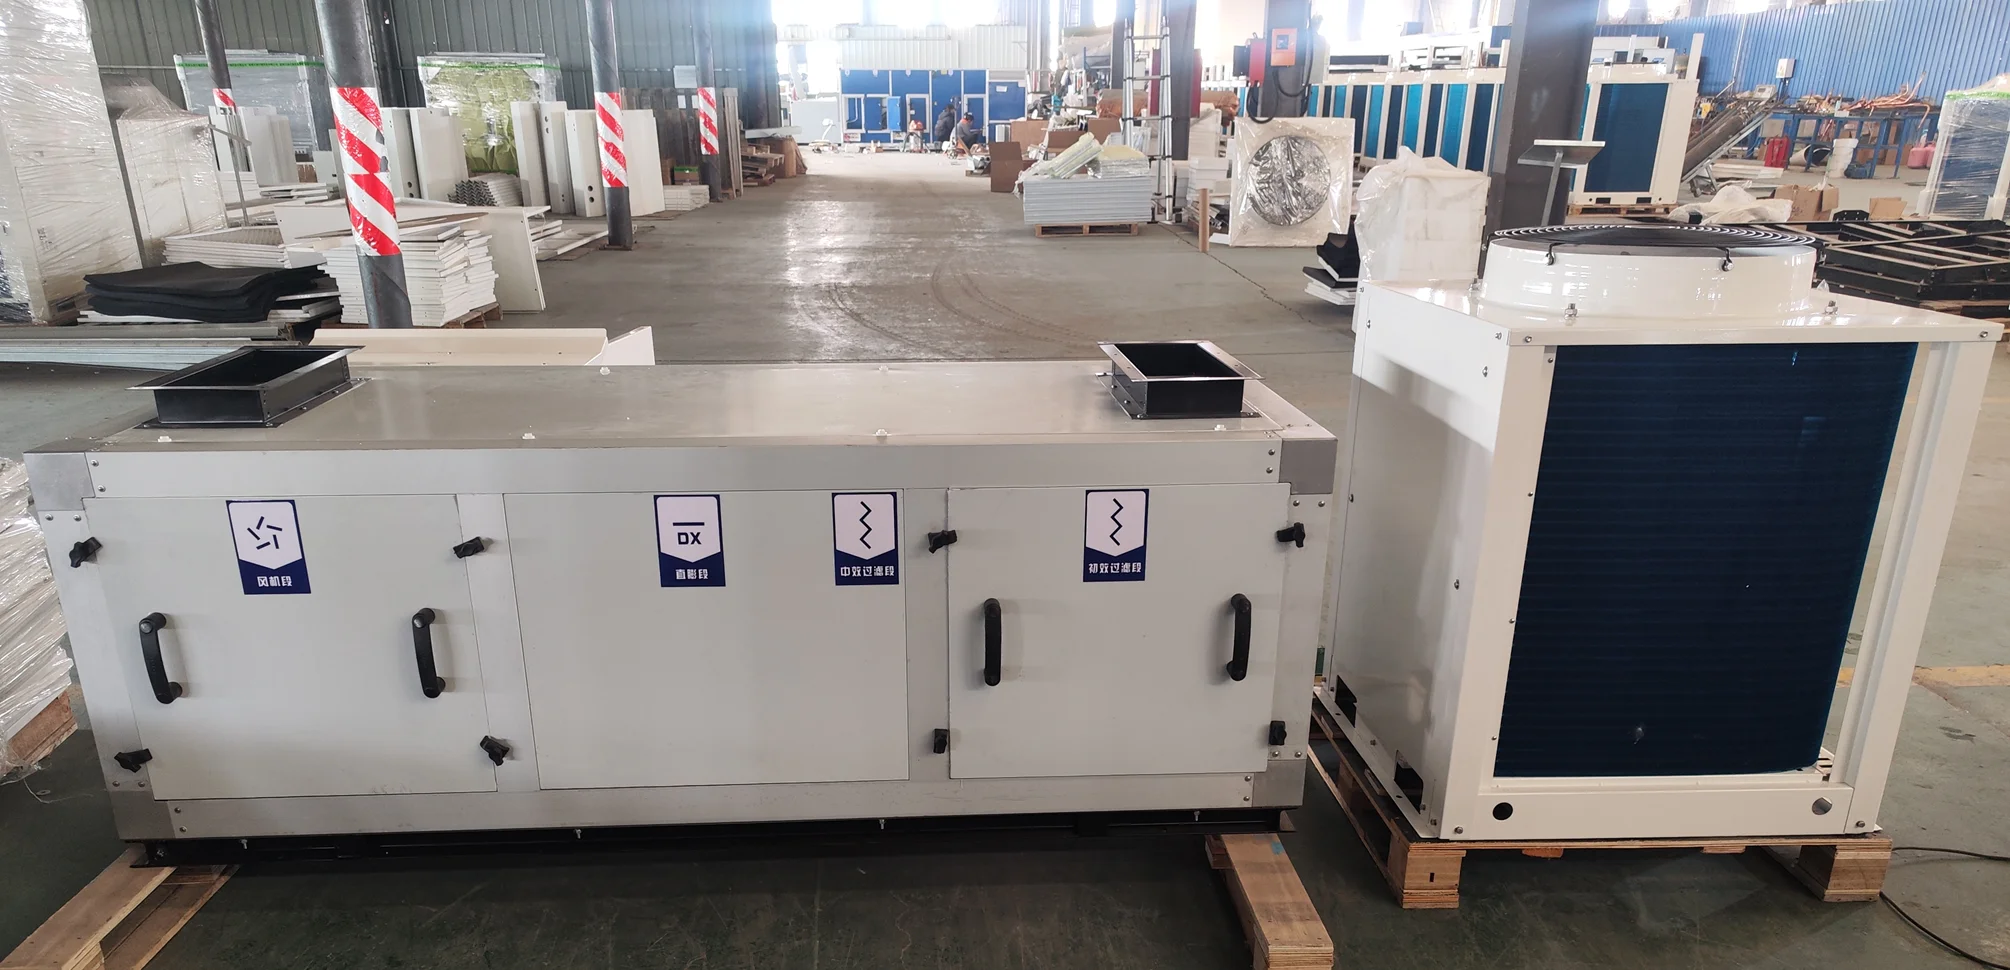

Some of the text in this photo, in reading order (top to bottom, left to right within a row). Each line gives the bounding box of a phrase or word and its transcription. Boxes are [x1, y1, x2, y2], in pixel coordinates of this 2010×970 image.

[677, 531, 702, 545] DX
[675, 568, 709, 580] 直膨段
[840, 565, 895, 578] 中效过滤段
[1088, 562, 1142, 574] 初效过滤段
[256, 575, 293, 588] 风机段
